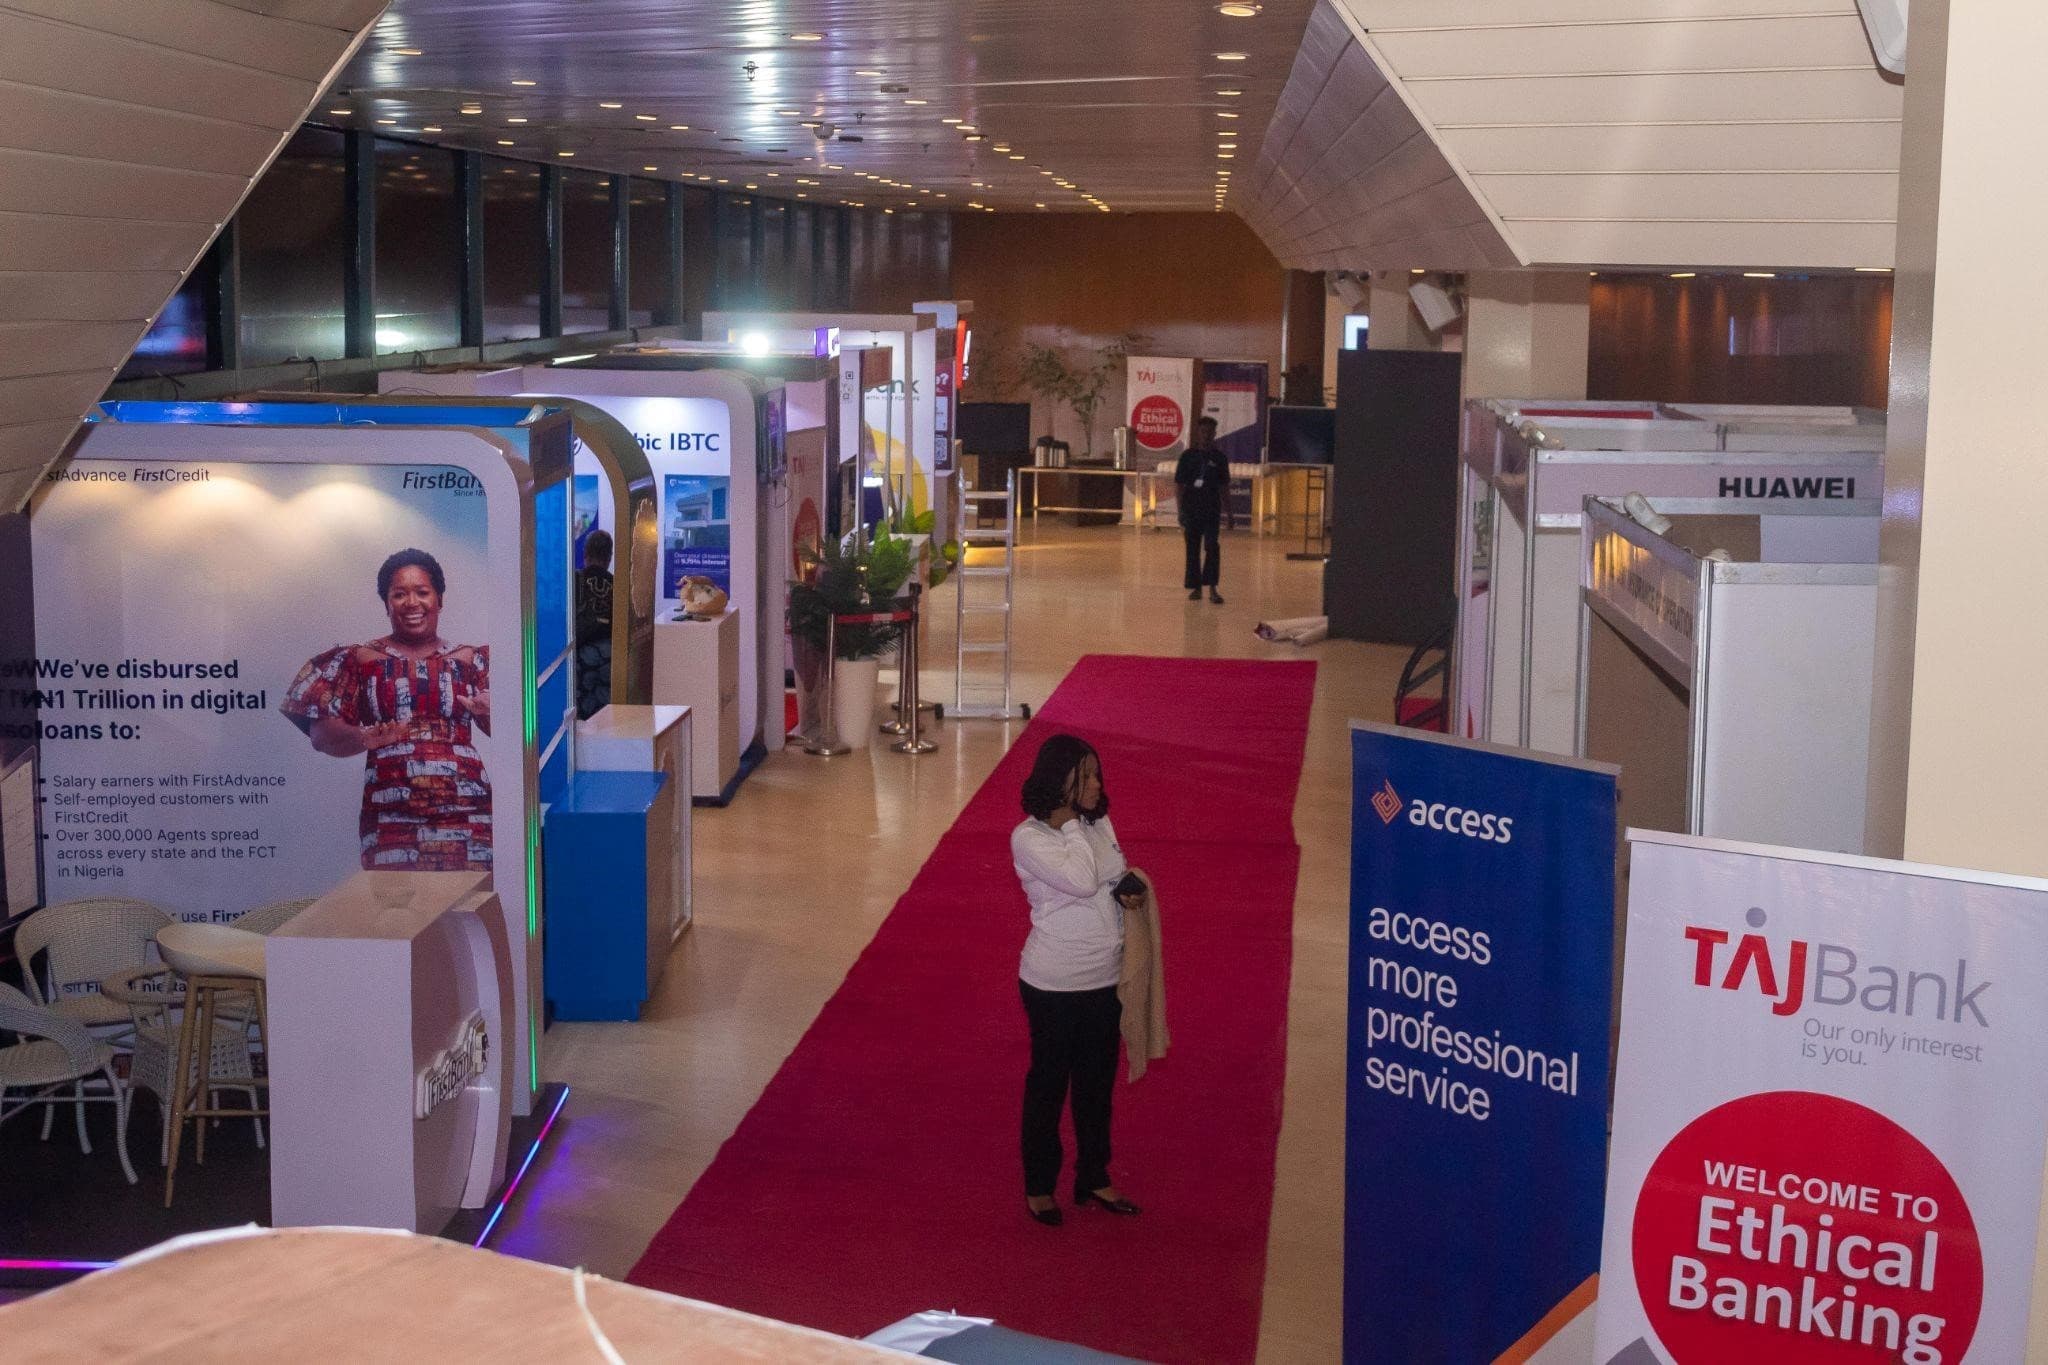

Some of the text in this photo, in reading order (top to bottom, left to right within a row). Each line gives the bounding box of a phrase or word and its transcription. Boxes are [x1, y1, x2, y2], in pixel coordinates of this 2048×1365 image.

[670, 432, 720, 451] IBTC
[47, 468, 210, 482] stAdvance FirstCredit
[402, 471, 484, 490] FirstBan
[1719, 477, 1855, 499] HUAWEI
[116, 658, 239, 679] disbursed
[73, 689, 156, 709] Trillion
[163, 689, 184, 709] in
[190, 689, 267, 715] digital
[36, 720, 103, 740] loans
[110, 721, 141, 740] to:
[53, 773, 286, 789] Salary earners with FirstAdvance
[54, 792, 269, 807] Self-employed customers with
[54, 811, 129, 824] FirstCredit
[1409, 799, 1513, 844] access
[56, 828, 260, 844] Over 300,000 Agents spread
[57, 846, 277, 862] across every state and the FCT
[58, 864, 124, 880] in Nigeria
[181, 911, 208, 923] use
[1369, 907, 1492, 965] access
[1684, 910, 1993, 1028] TAJBank
[1369, 956, 1458, 1008] more
[1367, 1005, 1579, 1096] professional
[1803, 1018, 1983, 1063] Our only interest
[1801, 1040, 1868, 1067] is you.
[1365, 1057, 1490, 1121] service
[1704, 1160, 1939, 1224] WELCOME TO
[1696, 1195, 1939, 1292] Ethical
[1667, 1254, 1947, 1365] Banking
